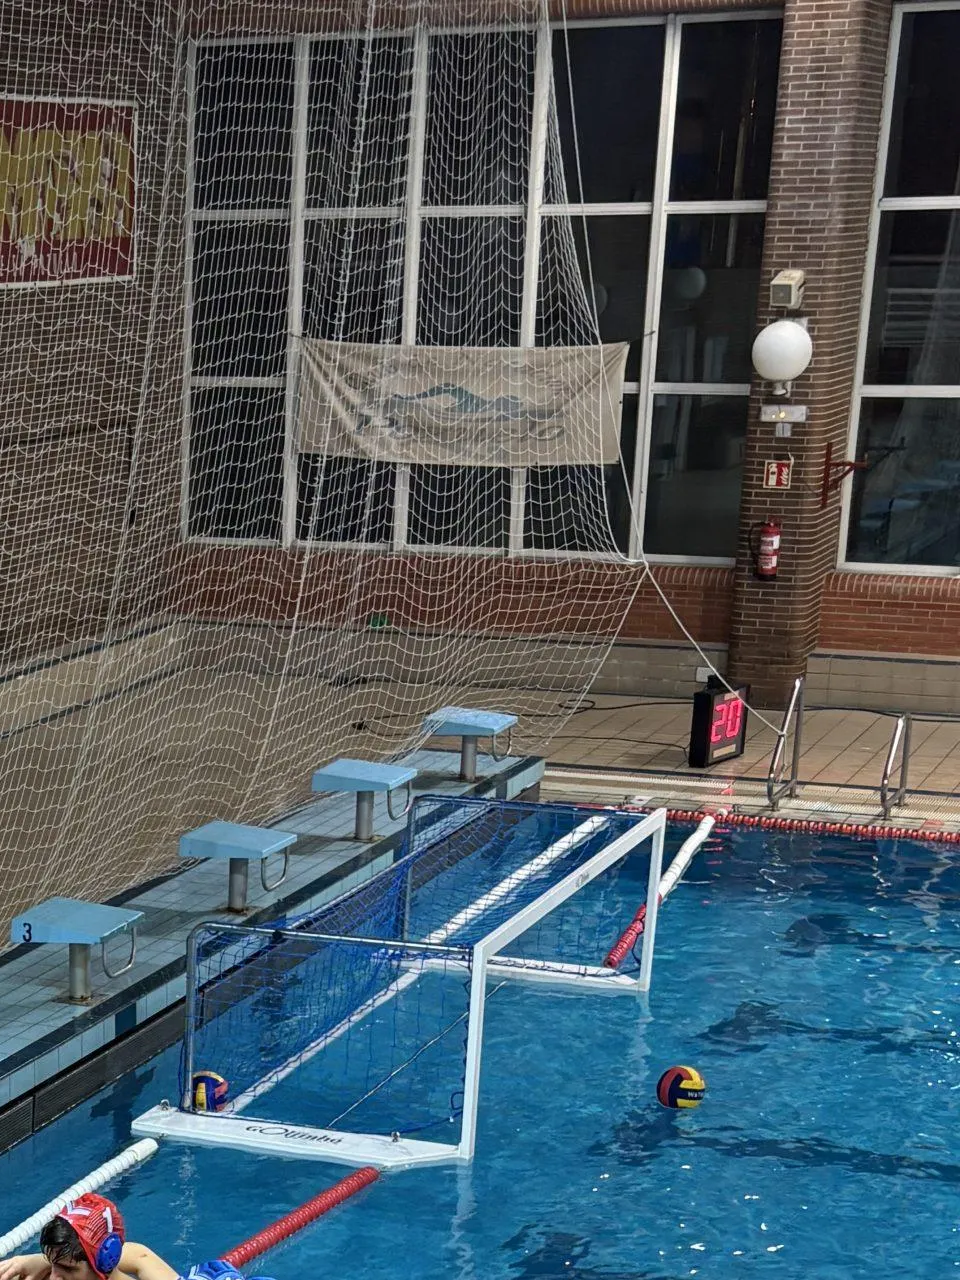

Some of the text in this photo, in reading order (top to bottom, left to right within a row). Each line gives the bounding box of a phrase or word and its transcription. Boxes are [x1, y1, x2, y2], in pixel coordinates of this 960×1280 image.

[710, 699, 742, 743] 20
[22, 922, 32, 943] 3
[102, 1207, 113, 1233] 1
